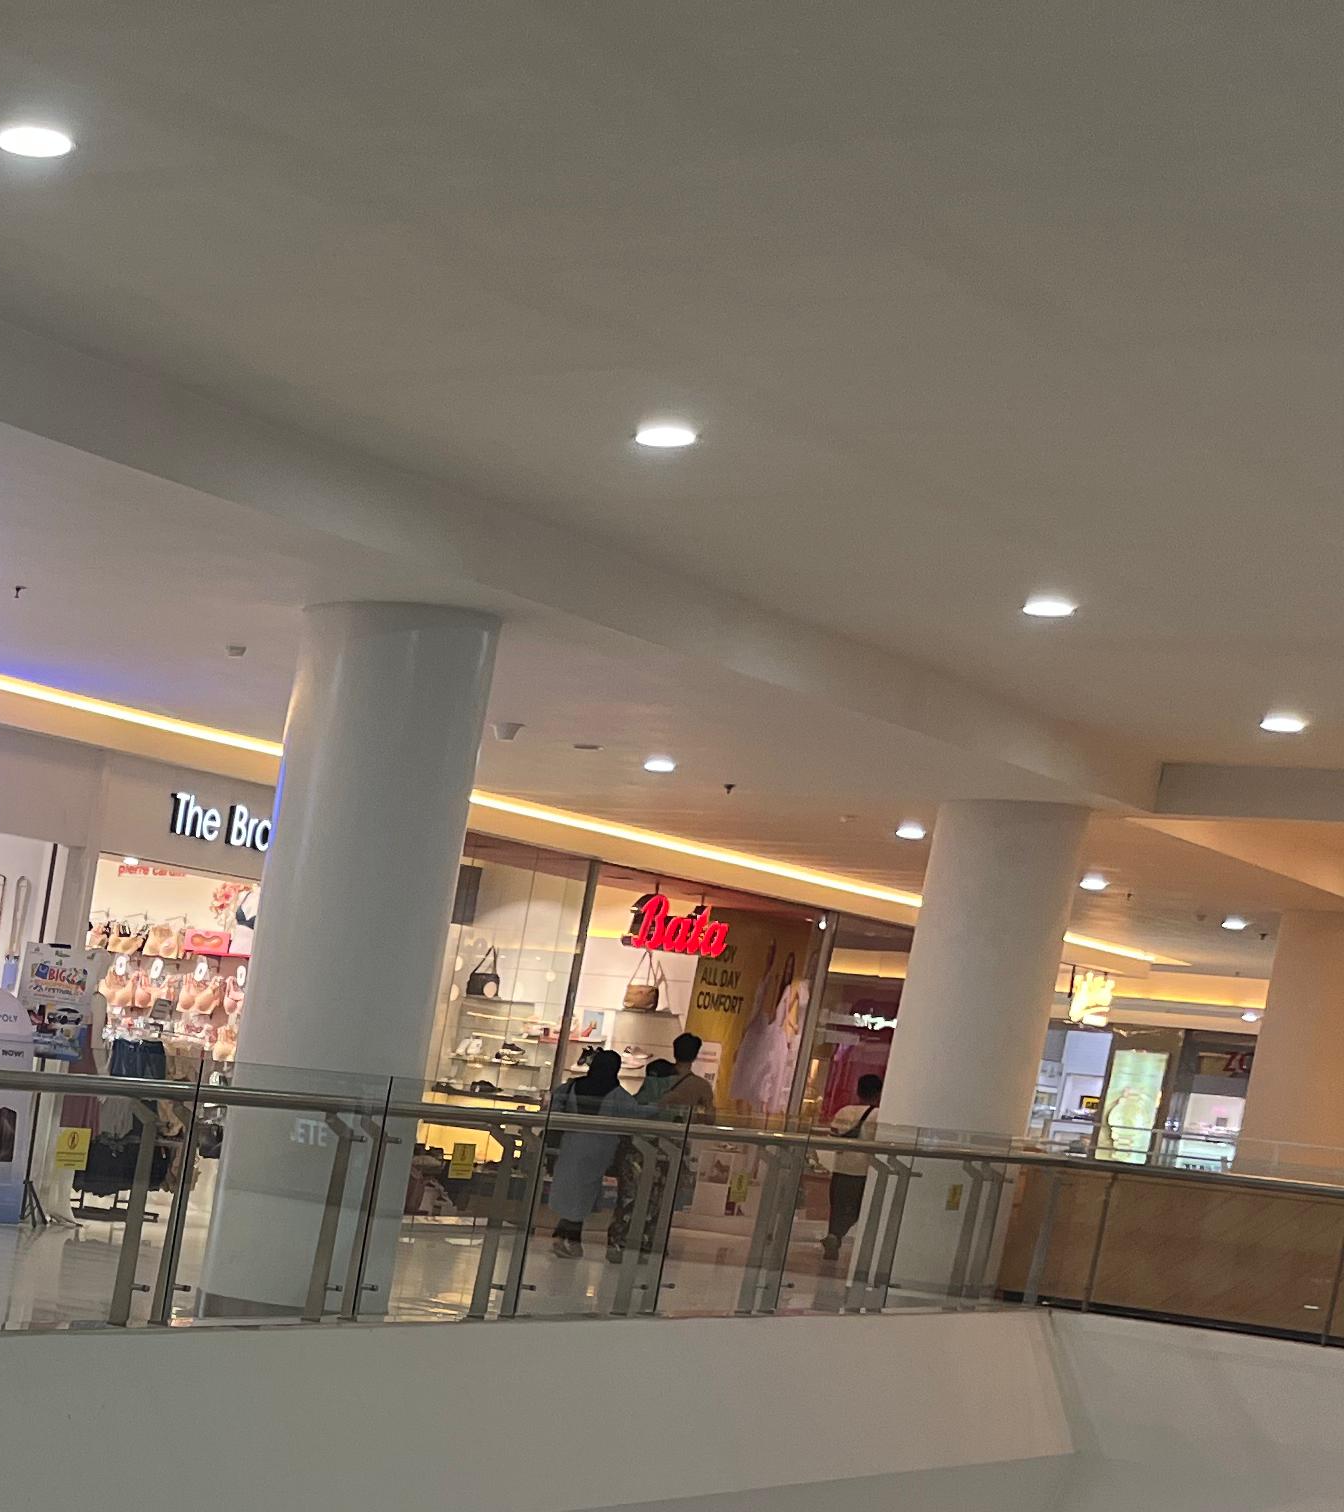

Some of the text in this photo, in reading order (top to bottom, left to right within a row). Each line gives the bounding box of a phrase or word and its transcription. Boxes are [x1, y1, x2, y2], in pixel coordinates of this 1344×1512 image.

[176, 791, 221, 841] The
[631, 894, 730, 957] Bata
[700, 969, 741, 990] ALL DAY
[696, 991, 744, 1015] COMFORT
